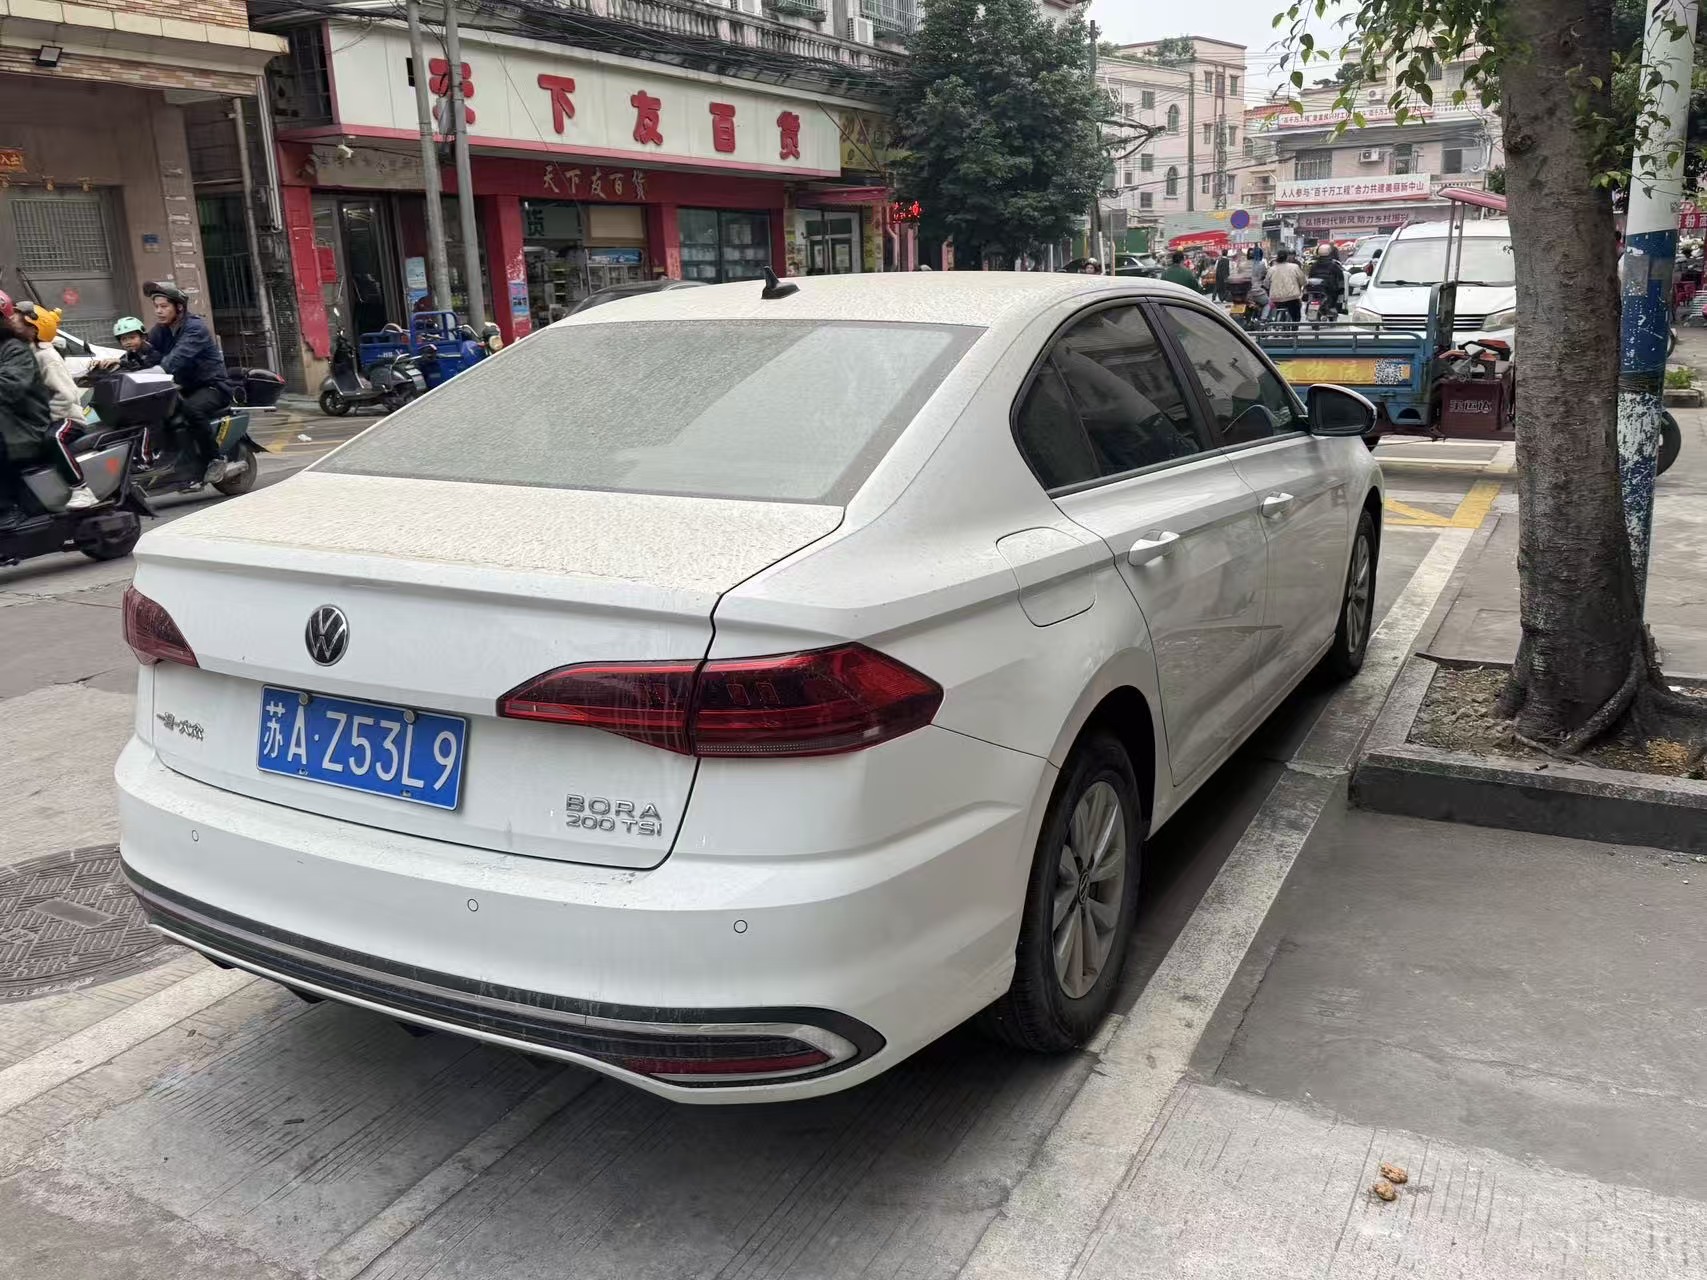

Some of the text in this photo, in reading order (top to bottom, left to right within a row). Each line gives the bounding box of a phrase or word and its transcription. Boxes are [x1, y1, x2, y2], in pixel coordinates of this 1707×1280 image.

[543, 165, 648, 200] 天下友百货
[566, 793, 662, 821] BORA
[566, 812, 662, 836] 200 TSI
